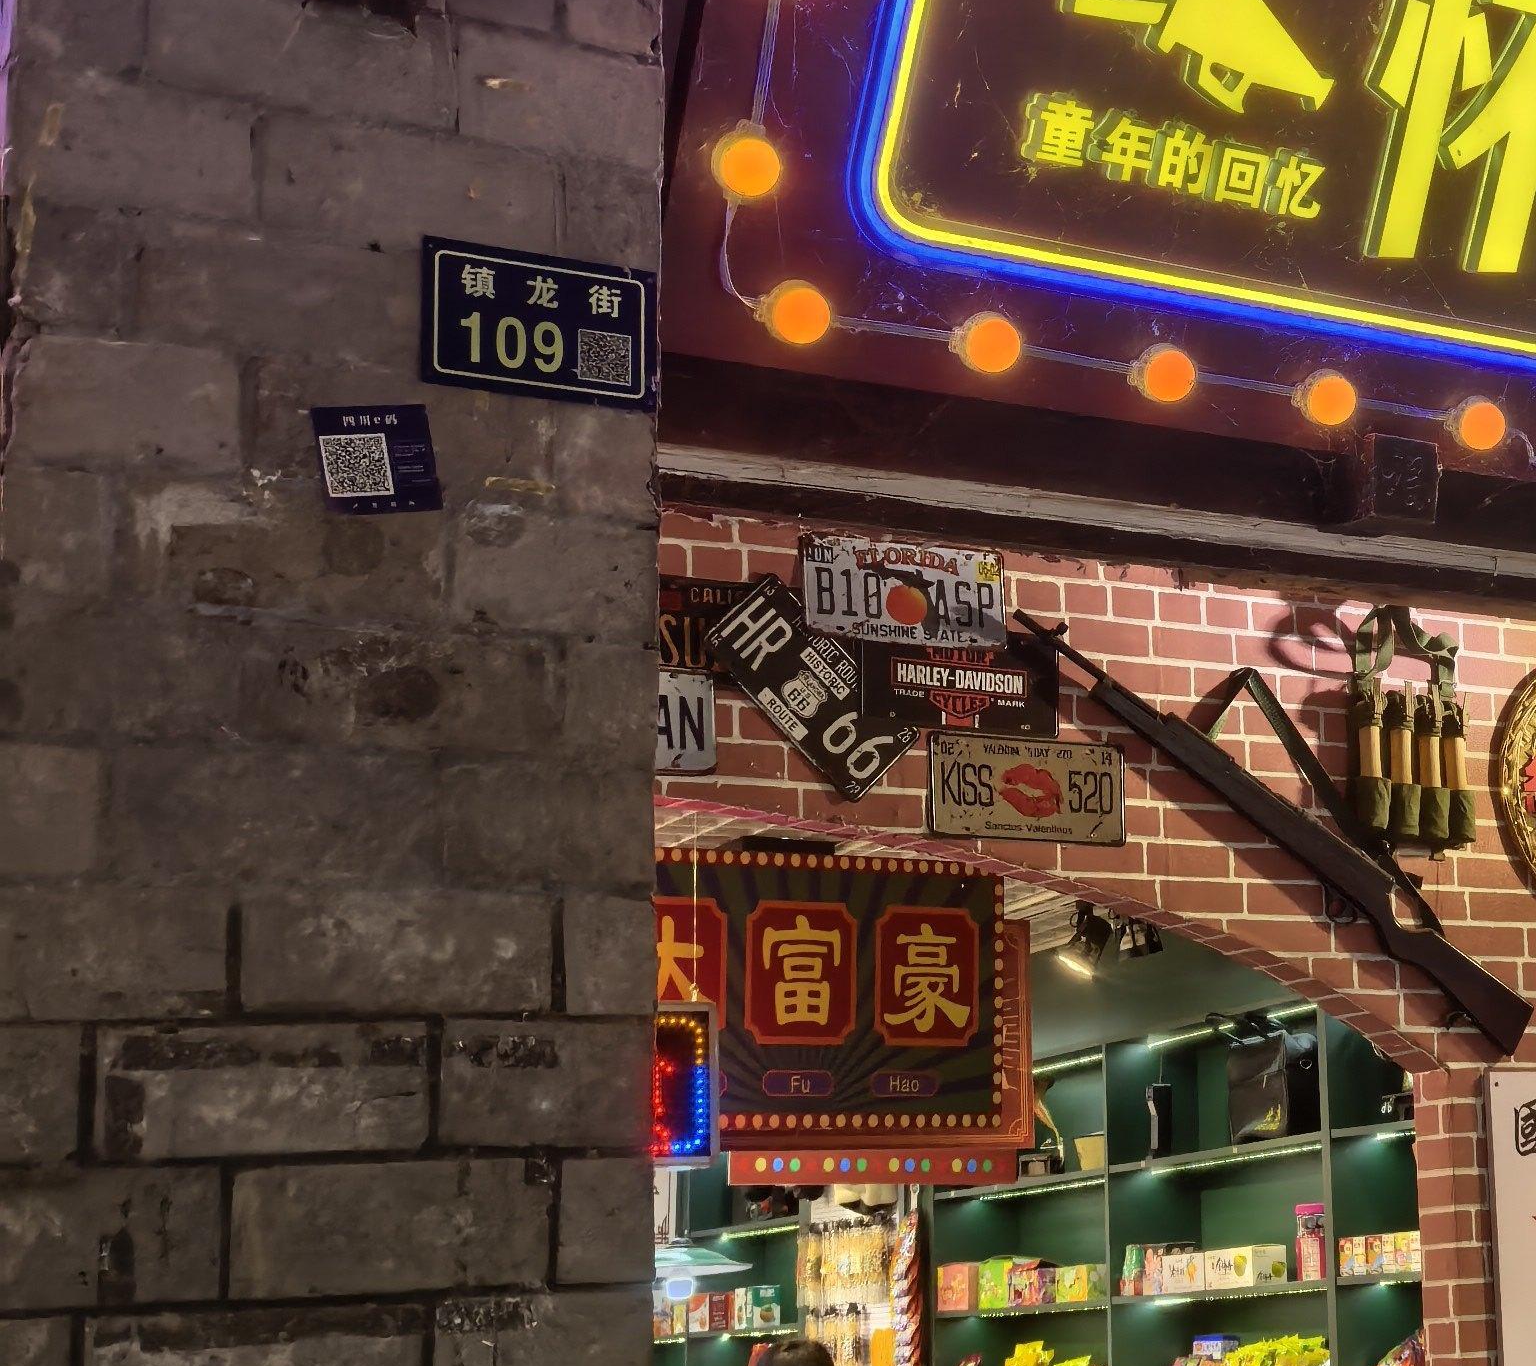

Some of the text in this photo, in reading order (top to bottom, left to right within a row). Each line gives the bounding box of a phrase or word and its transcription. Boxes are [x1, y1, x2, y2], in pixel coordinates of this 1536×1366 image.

[1024, 93, 1326, 219] 童年的回忆
[460, 263, 622, 318] 镇龙街
[460, 311, 564, 373] 109
[852, 546, 960, 576] FLORIDA
[689, 588, 737, 604] CALI
[932, 578, 995, 628] ASP
[720, 596, 793, 671] HR
[850, 622, 918, 640] SUNSHINE
[803, 649, 847, 696] HISTORIC
[896, 662, 1023, 695] HARLEY-DAVIDSON
[766, 697, 797, 732] ROUTE
[893, 688, 1025, 709] TRADE MARK
[823, 711, 894, 779] 66
[940, 761, 1113, 815] KISS 520
[790, 1076, 920, 1094] Fu Hao
